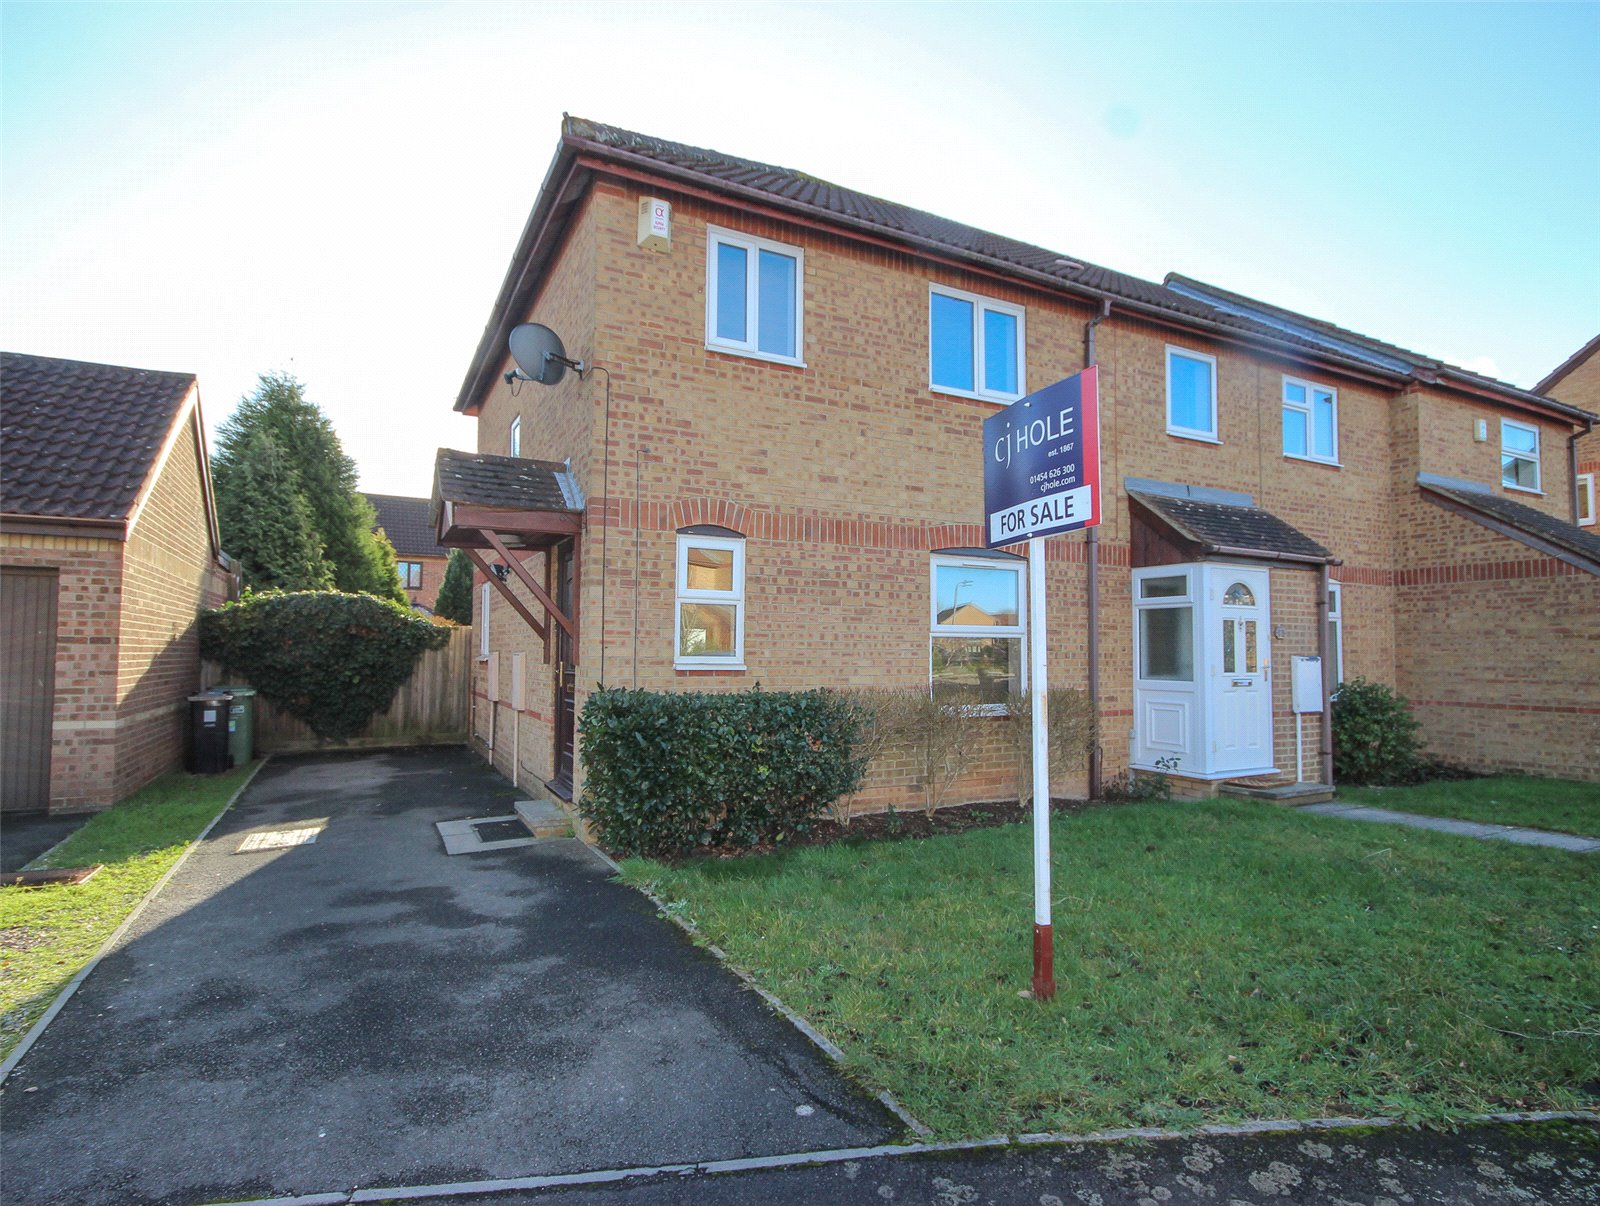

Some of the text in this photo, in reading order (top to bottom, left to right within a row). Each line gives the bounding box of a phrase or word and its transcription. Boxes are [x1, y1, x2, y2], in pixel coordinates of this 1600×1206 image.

[1016, 407, 1074, 453] HOLE
[1048, 442, 1074, 458] est. 1867
[1030, 464, 1075, 484] 01454 626 300
[1040, 476, 1076, 492] cjhole.com
[1000, 495, 1075, 534] FOR SALE
